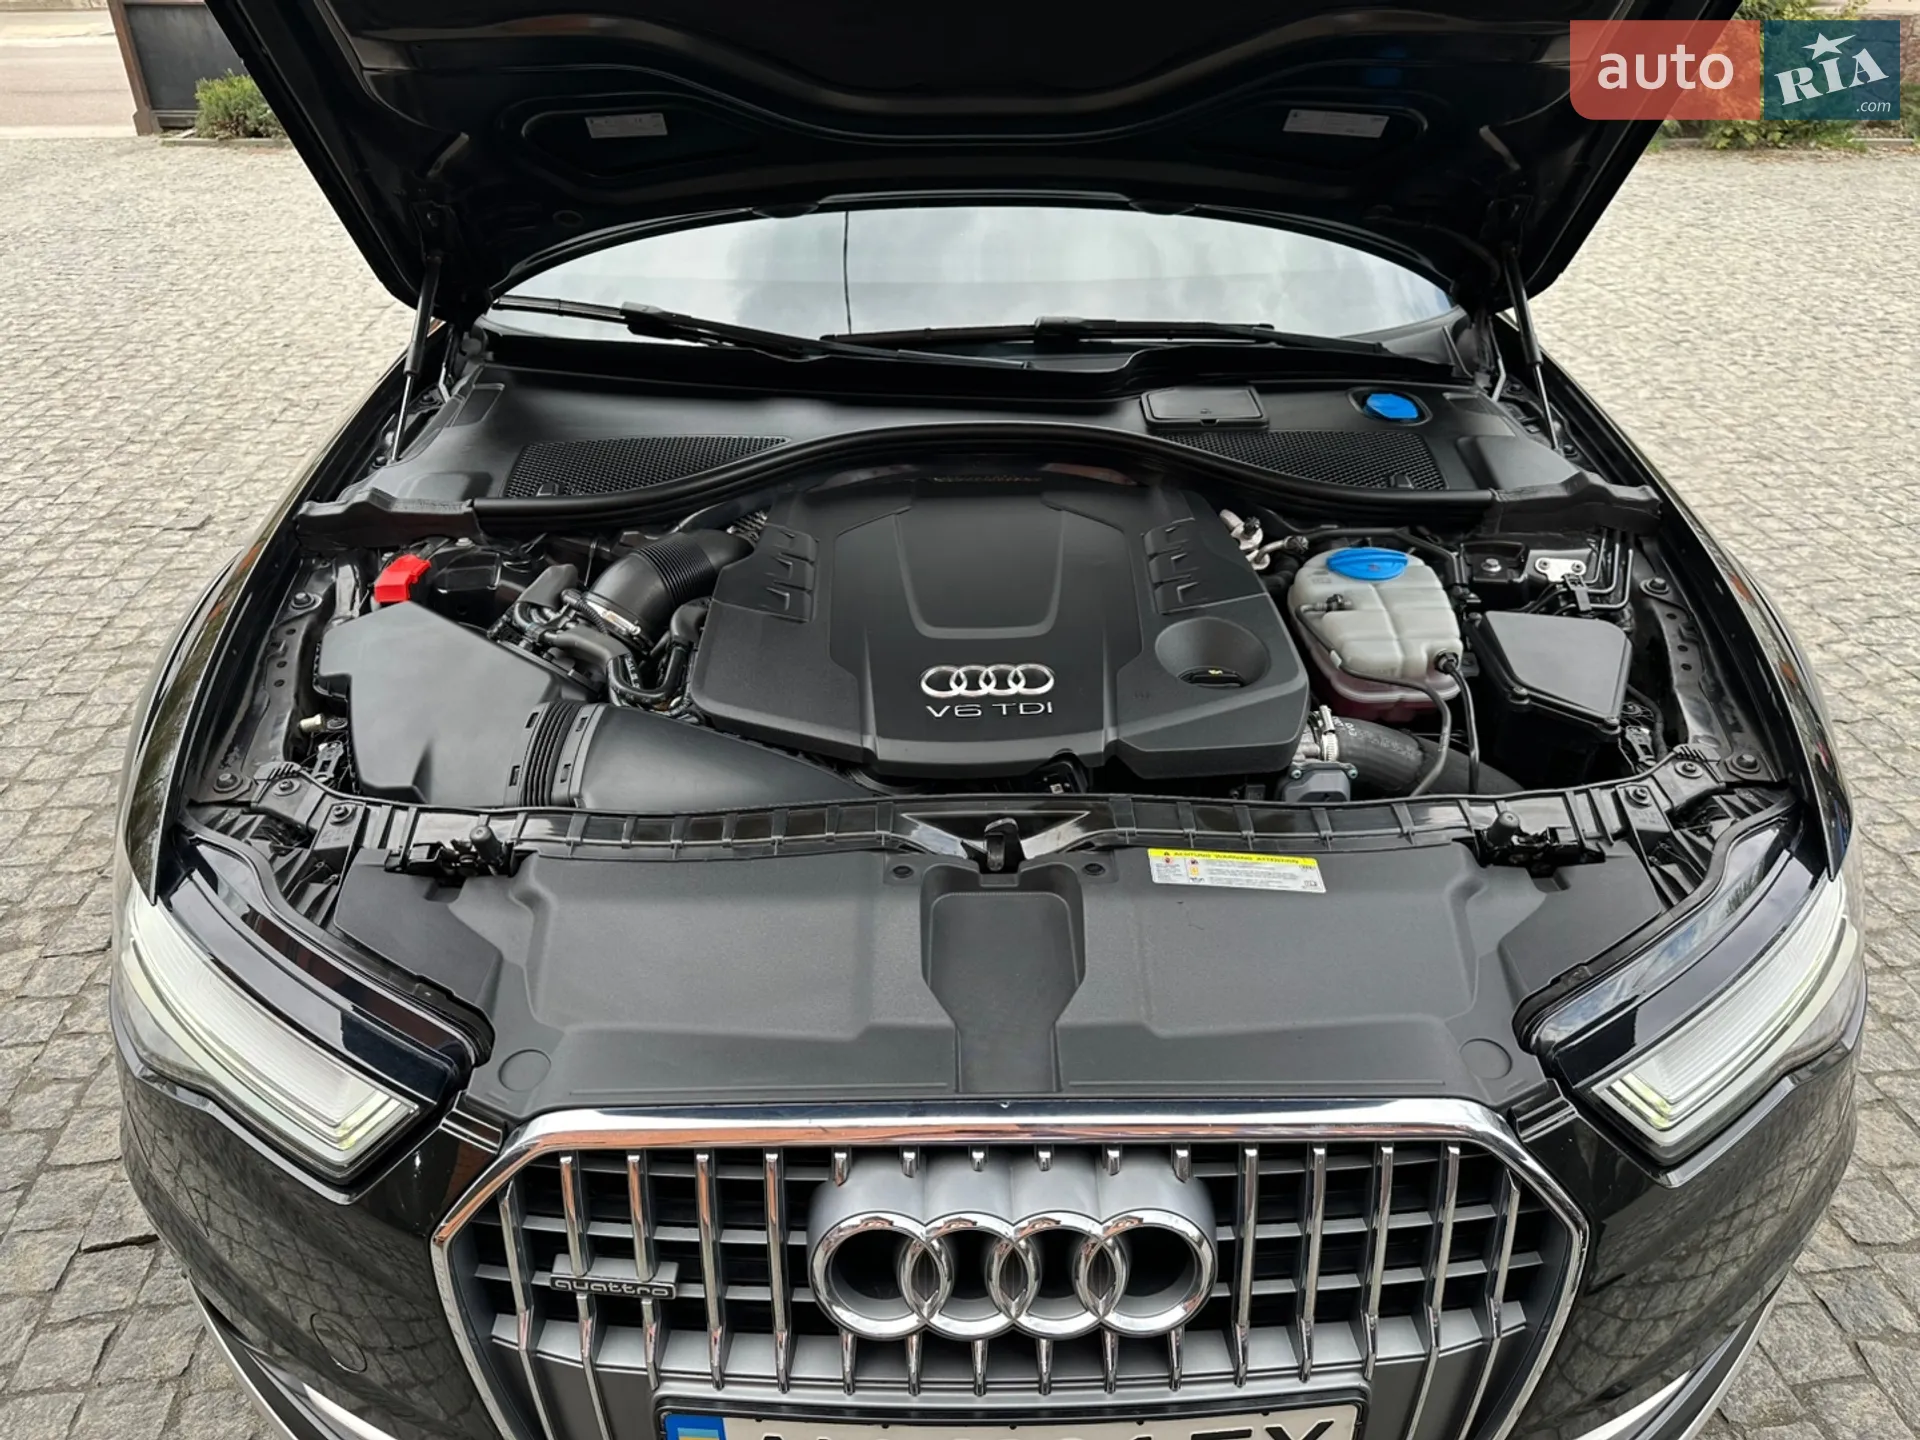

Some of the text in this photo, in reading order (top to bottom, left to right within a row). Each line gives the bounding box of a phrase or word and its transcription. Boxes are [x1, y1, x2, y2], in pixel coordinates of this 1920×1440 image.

[926, 701, 1053, 718] V6 TDI
[554, 1279, 669, 1296] quattro
